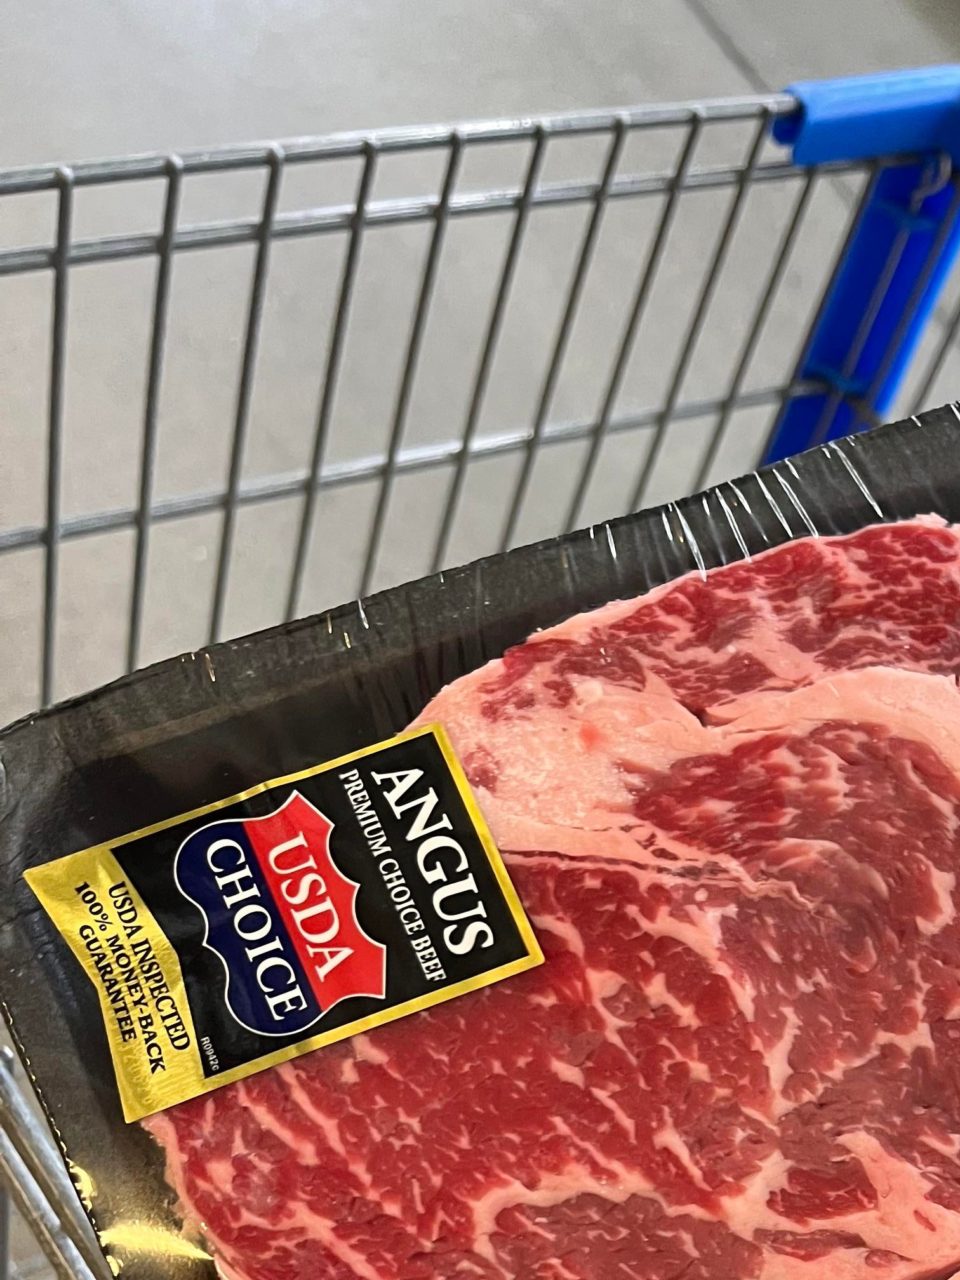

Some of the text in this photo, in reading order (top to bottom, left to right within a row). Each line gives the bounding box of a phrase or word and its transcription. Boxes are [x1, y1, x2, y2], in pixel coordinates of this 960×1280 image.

[206, 838, 308, 1021] CHOICE
[268, 830, 355, 983] USDA
[338, 768, 447, 981] PREMIUM CHOICE BEEF
[370, 768, 494, 955] ANGUS
[73, 878, 113, 935] 100%
[104, 933, 167, 1075] MONEY-BACK
[78, 924, 138, 1044] GUARANTEE
[108, 879, 144, 940] USDA
[129, 937, 191, 1051] INSPECTED
